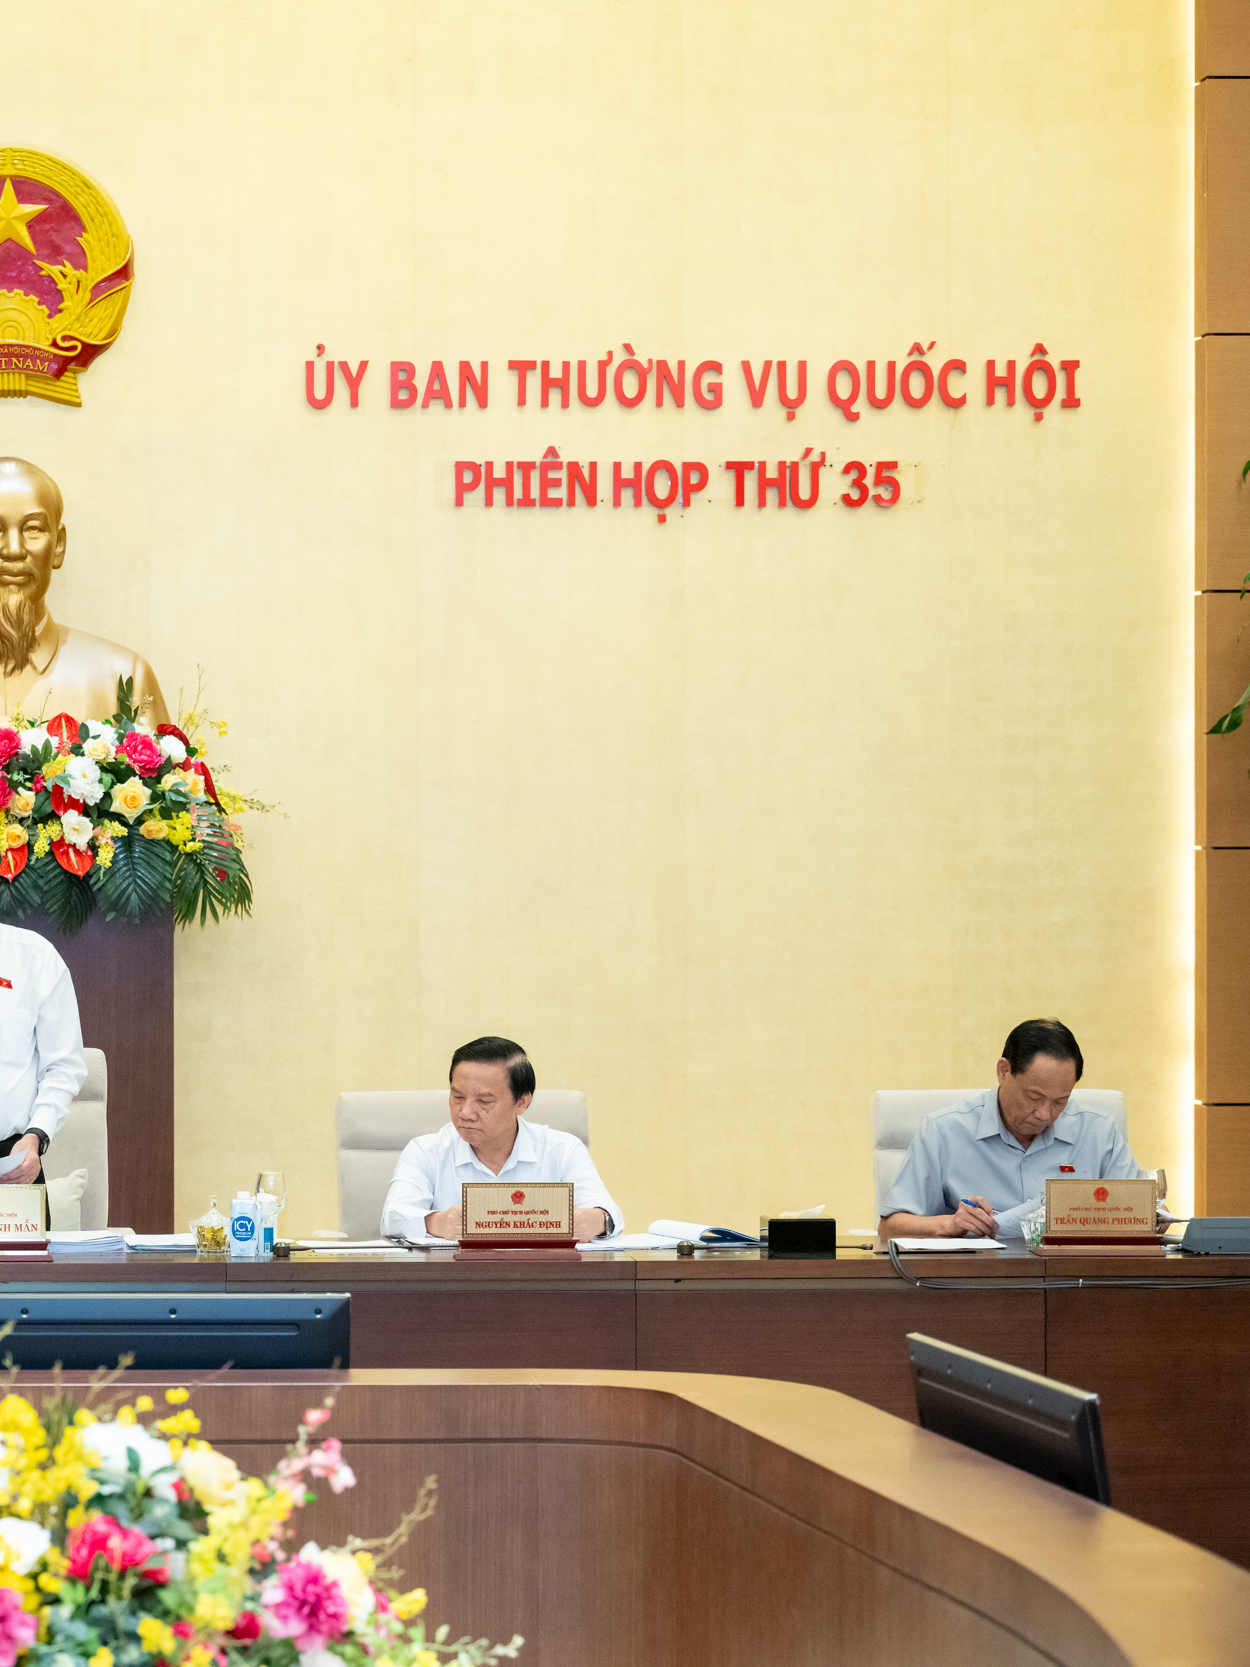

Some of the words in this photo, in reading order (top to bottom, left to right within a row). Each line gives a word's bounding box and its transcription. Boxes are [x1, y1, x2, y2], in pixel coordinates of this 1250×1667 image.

[11, 357, 50, 372] NAM
[305, 343, 369, 409] ỦY
[390, 360, 489, 409] BAN
[508, 343, 723, 409] THƯỜNG
[741, 360, 807, 420] VỤ
[827, 341, 967, 421] QUỐC
[985, 343, 1081, 421] HỘI
[455, 445, 598, 508] PHIÊN
[613, 459, 709, 523] HỌP
[725, 447, 826, 509] THỨ
[841, 460, 901, 508] 35
[234, 1220, 253, 1231] ICY
[539, 1220, 561, 1230] ĐỊNH
[1079, 1217, 1109, 1226] QUANG
